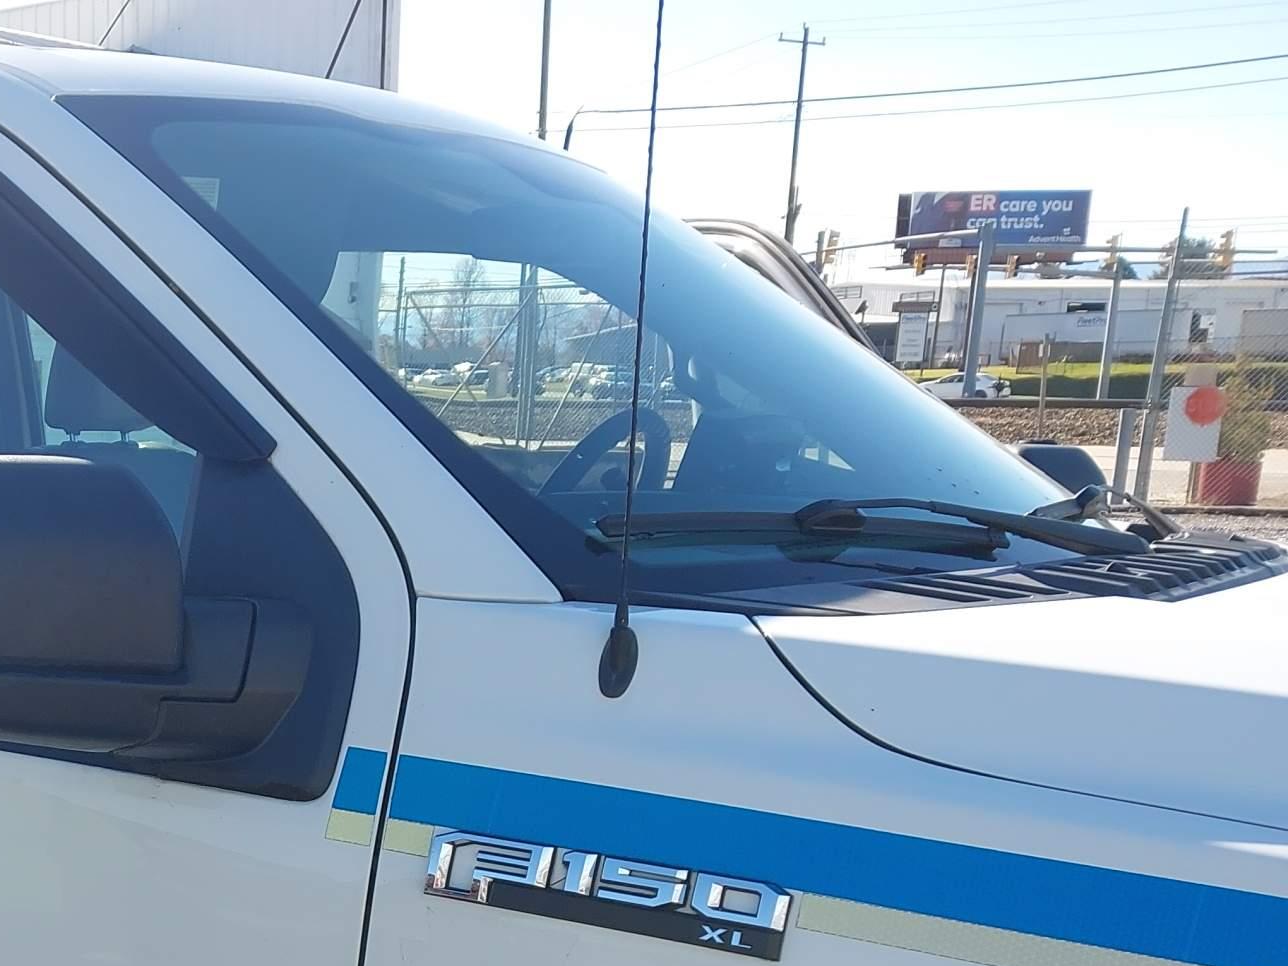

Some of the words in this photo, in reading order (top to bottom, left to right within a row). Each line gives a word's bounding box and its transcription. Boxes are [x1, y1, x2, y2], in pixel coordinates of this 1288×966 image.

[970, 194, 996, 211] ER
[999, 199, 1037, 212] care
[1042, 198, 1073, 215] you
[1000, 214, 1044, 229] trust.
[698, 925, 753, 949] XL
